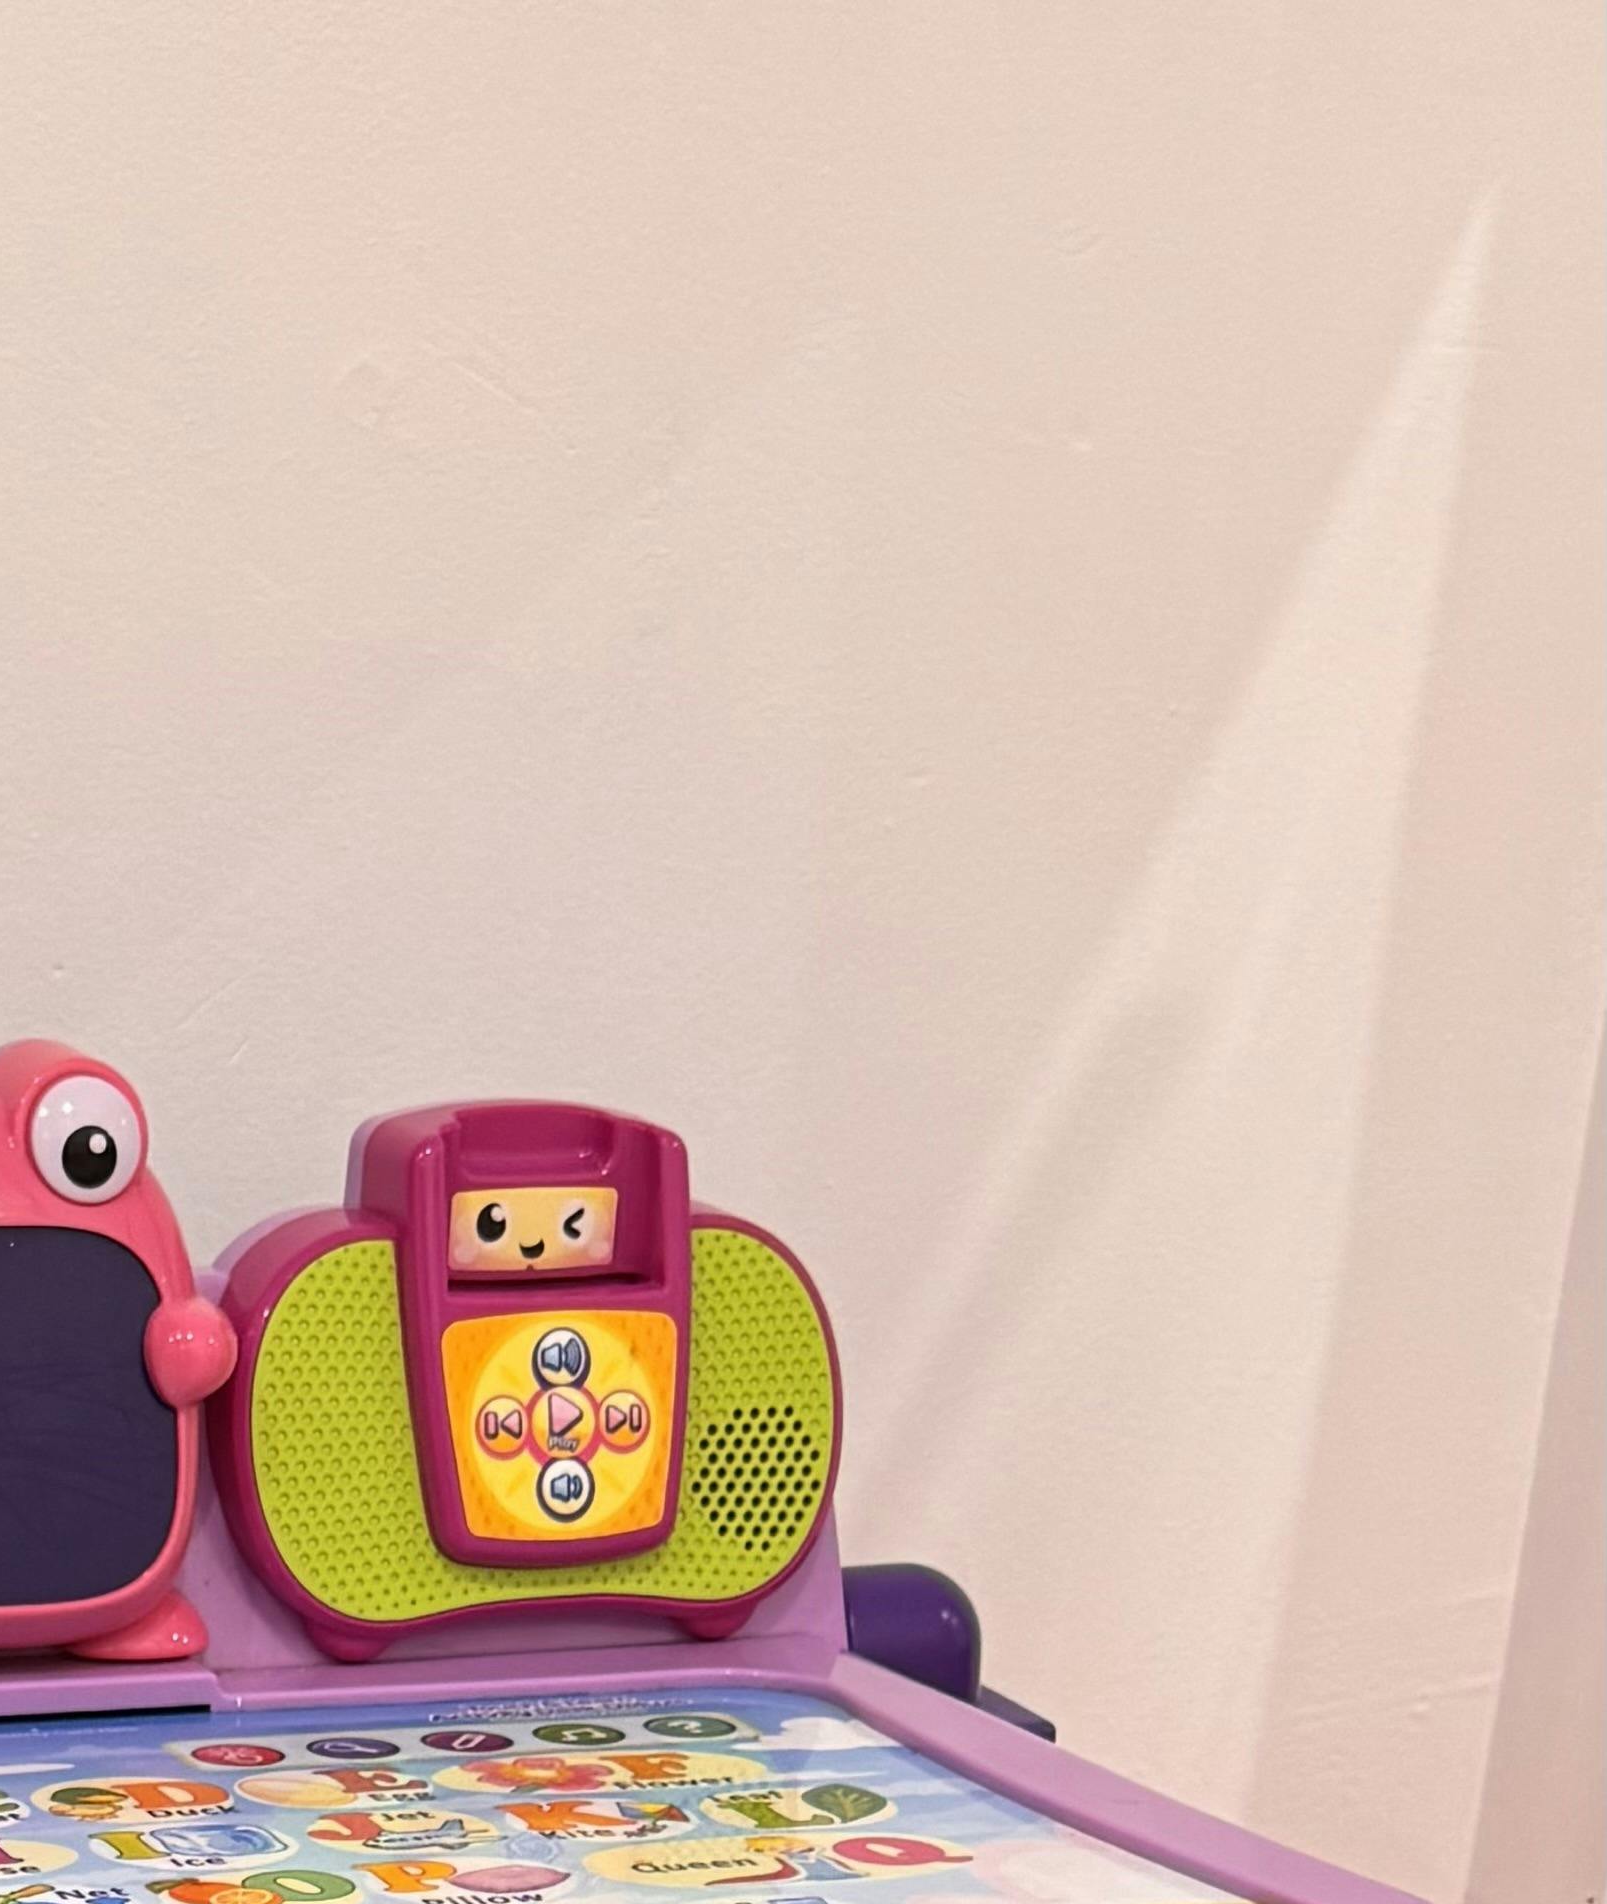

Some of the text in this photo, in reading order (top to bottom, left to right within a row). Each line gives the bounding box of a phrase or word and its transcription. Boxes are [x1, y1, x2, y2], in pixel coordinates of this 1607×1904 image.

[312, 1767, 429, 1793] E
[597, 1752, 690, 1780] F
[110, 1781, 231, 1809] D
[147, 1805, 240, 1818] Duck
[381, 1811, 435, 1822] Jet
[496, 1800, 639, 1832] K
[307, 1812, 384, 1841] J
[88, 1831, 172, 1860] I
[833, 1837, 973, 1865] Q
[169, 1856, 227, 1867] Ice
[631, 1857, 757, 1874] Queen
[242, 1870, 356, 1901] O
[351, 1860, 457, 1893] P
[55, 1887, 130, 1900] Net
